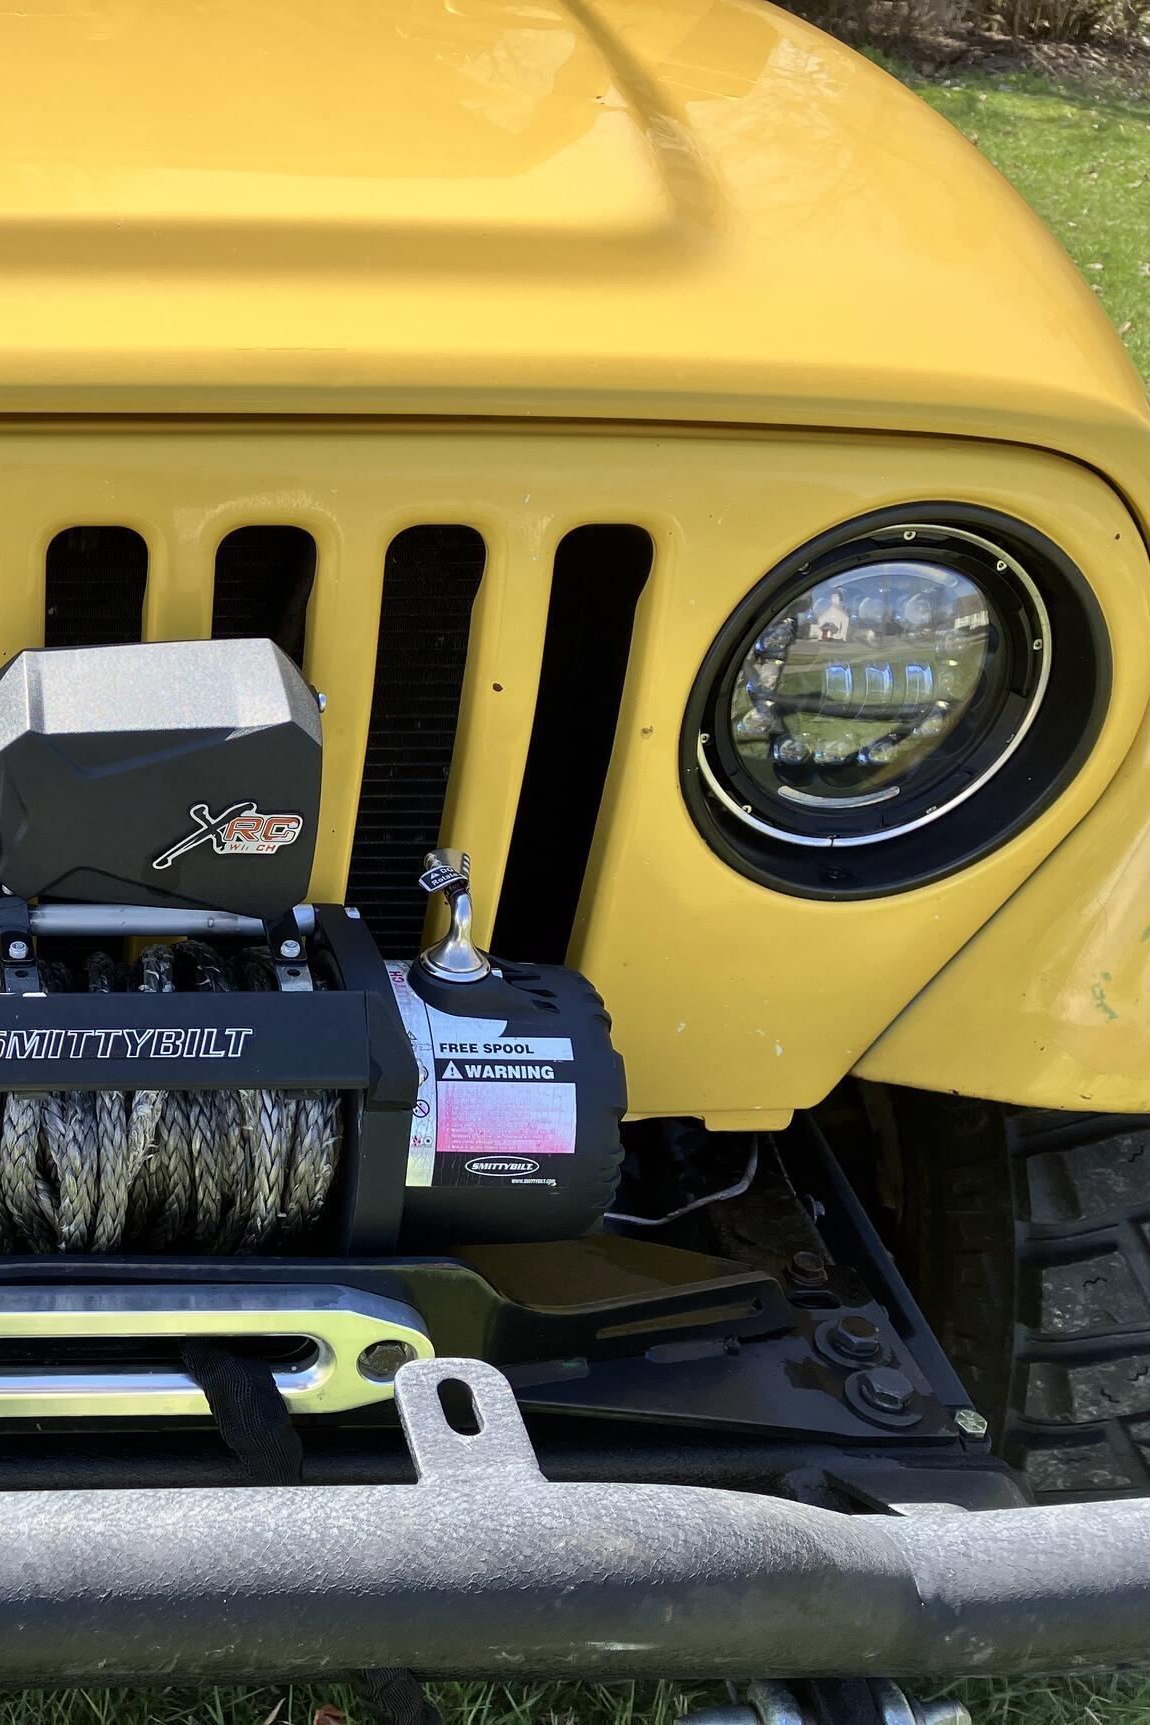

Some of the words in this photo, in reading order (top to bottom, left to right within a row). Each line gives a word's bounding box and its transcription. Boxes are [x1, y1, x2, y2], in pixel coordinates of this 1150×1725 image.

[152, 801, 303, 870] XRC
[229, 843, 277, 852] WICH
[439, 1043, 479, 1054] FREE
[483, 1043, 535, 1055] SPOOL
[464, 1064, 555, 1080] WARNING
